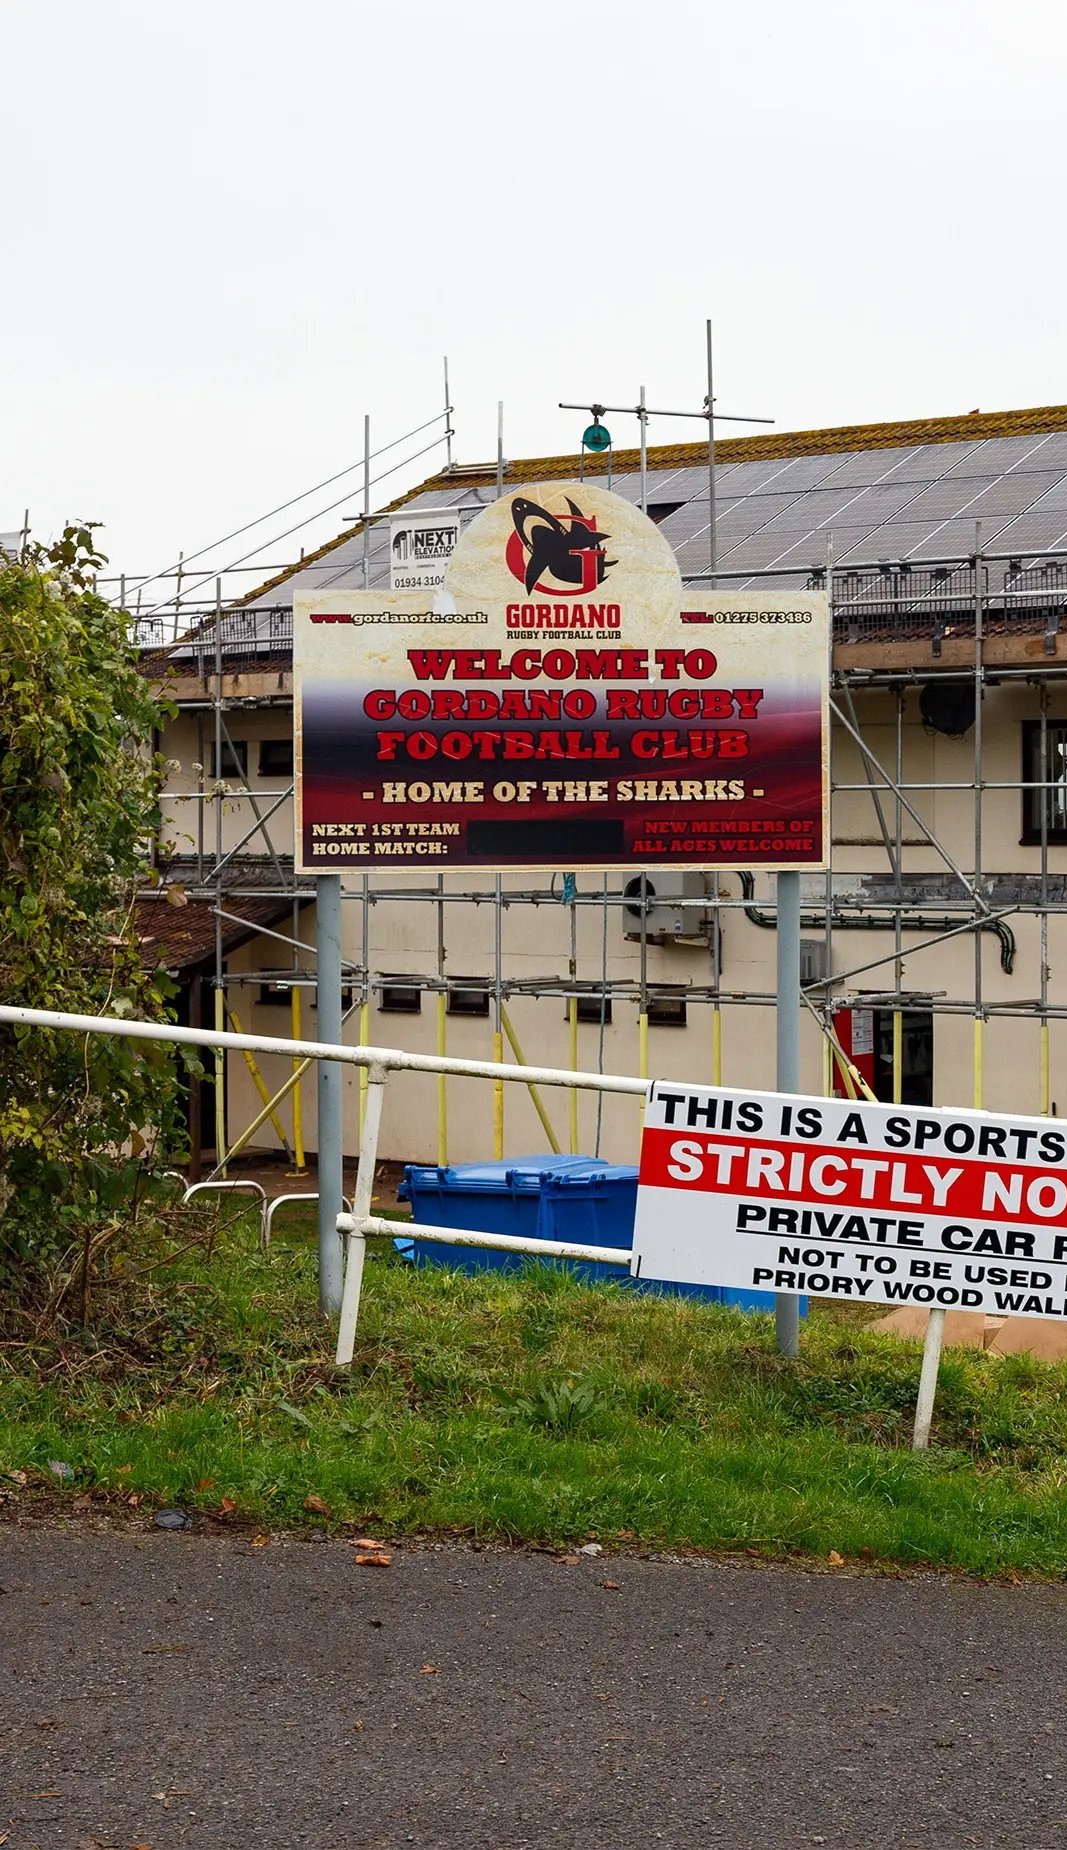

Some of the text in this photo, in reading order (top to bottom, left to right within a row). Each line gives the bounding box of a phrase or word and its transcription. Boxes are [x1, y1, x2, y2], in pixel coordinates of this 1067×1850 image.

[414, 530, 455, 548] NEXT
[394, 577, 422, 588] 01934
[310, 612, 488, 626] www.gordanorfc.co.uk
[506, 604, 621, 629] GORDANO
[680, 612, 812, 624] TEL: 01275 373486
[507, 630, 621, 640] RUGBY FOOTBALL CLUB
[407, 648, 718, 680] WELCOME TO
[363, 688, 764, 721] GORDANO RUGBY
[376, 729, 749, 761] FOOTBALL CLUB
[382, 781, 485, 804] HOME
[493, 781, 538, 803] OF
[542, 780, 609, 802] THE
[616, 779, 745, 802] SHARKS
[312, 823, 460, 837] NEXT 1ST TEAM
[643, 820, 814, 834] NEW MEMBERS OF
[312, 842, 449, 856] HOME MATCH:
[632, 839, 814, 853] ALL AGES WELCOME
[658, 1093, 762, 1132] THIS
[781, 1106, 822, 1138] IS
[837, 1113, 868, 1144] A
[884, 1116, 1065, 1163] SPORTS
[667, 1140, 964, 1207] STRICTLY
[736, 1203, 925, 1247] PRIVATE
[941, 1224, 1036, 1258] CAR
[779, 1246, 845, 1269] NOT
[856, 1254, 897, 1275] TO
[910, 1259, 953, 1281] BE
[965, 1264, 1053, 1290] USED
[752, 1267, 875, 1296] PRIORY
[883, 1281, 984, 1307] WOOD
